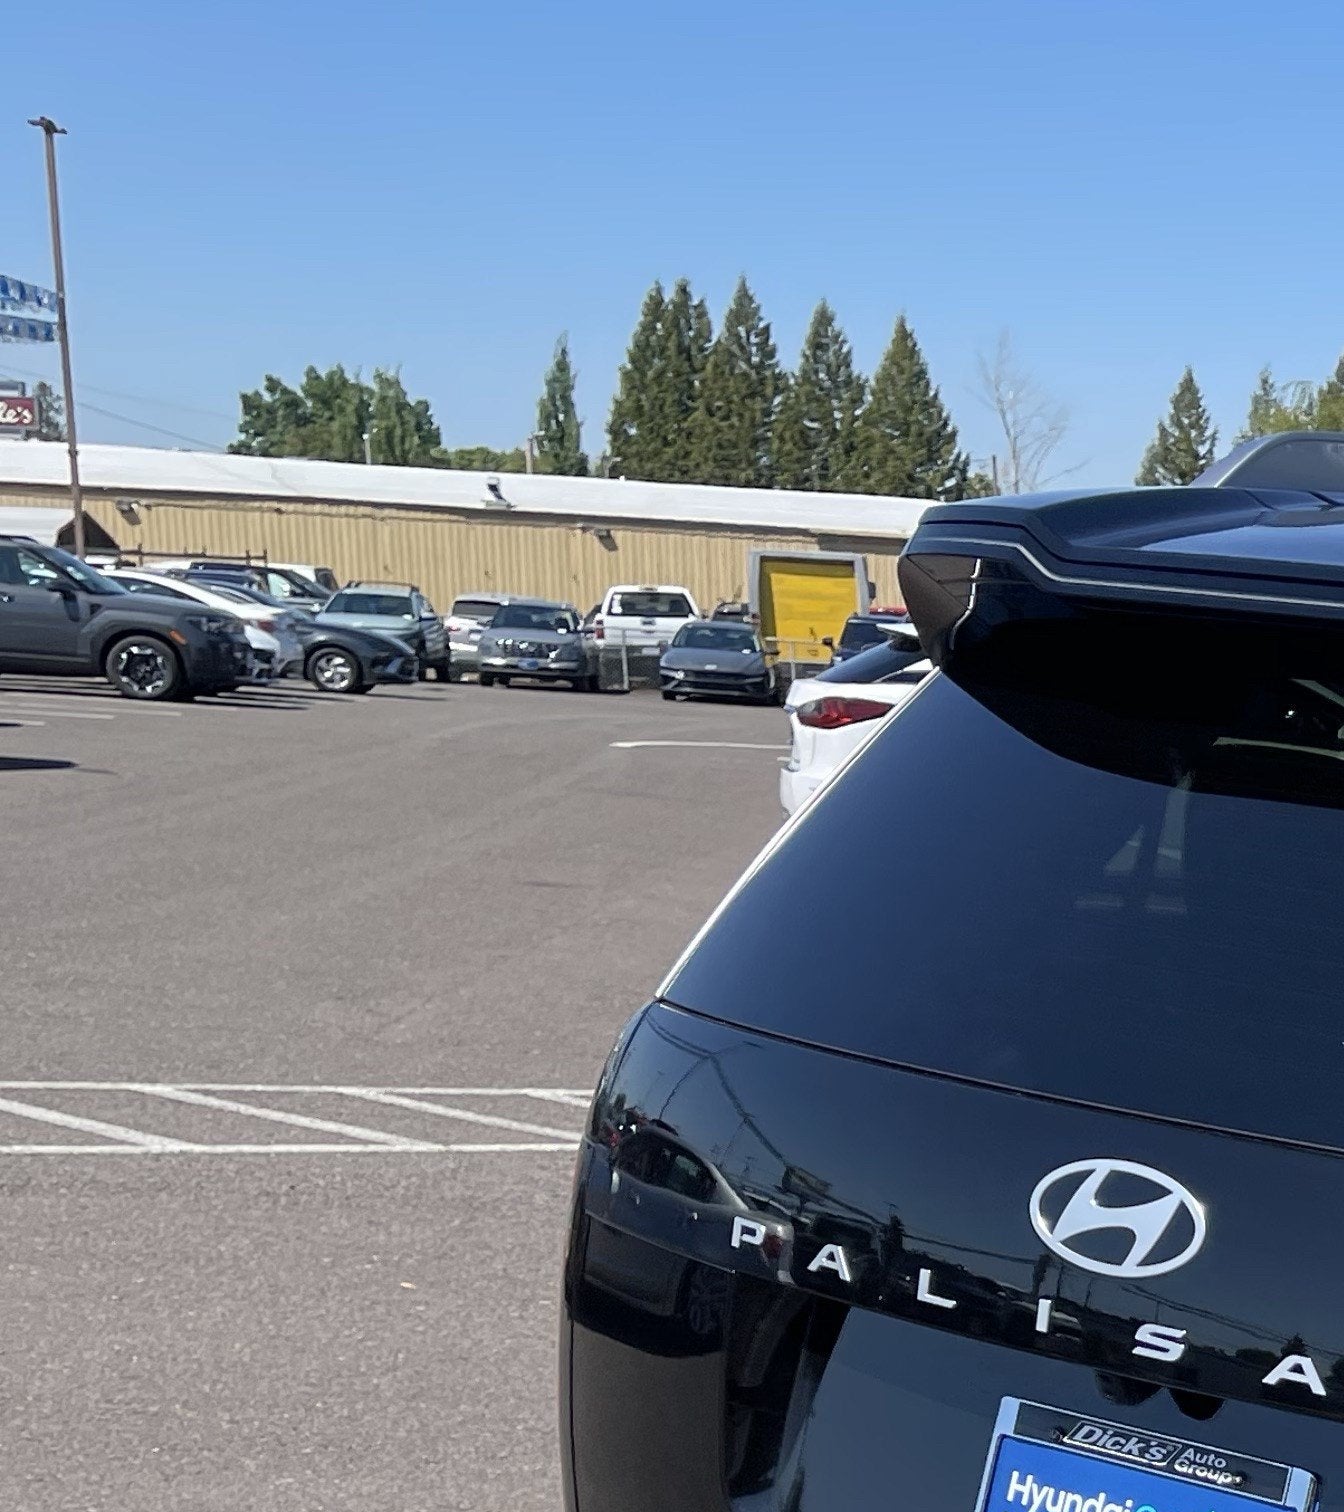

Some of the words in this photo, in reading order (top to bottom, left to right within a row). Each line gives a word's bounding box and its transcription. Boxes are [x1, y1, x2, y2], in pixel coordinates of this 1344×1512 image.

[1072, 1425, 1168, 1461] Dick's
[1173, 1458, 1232, 1485] Group
[1181, 1447, 1227, 1469] Auto
